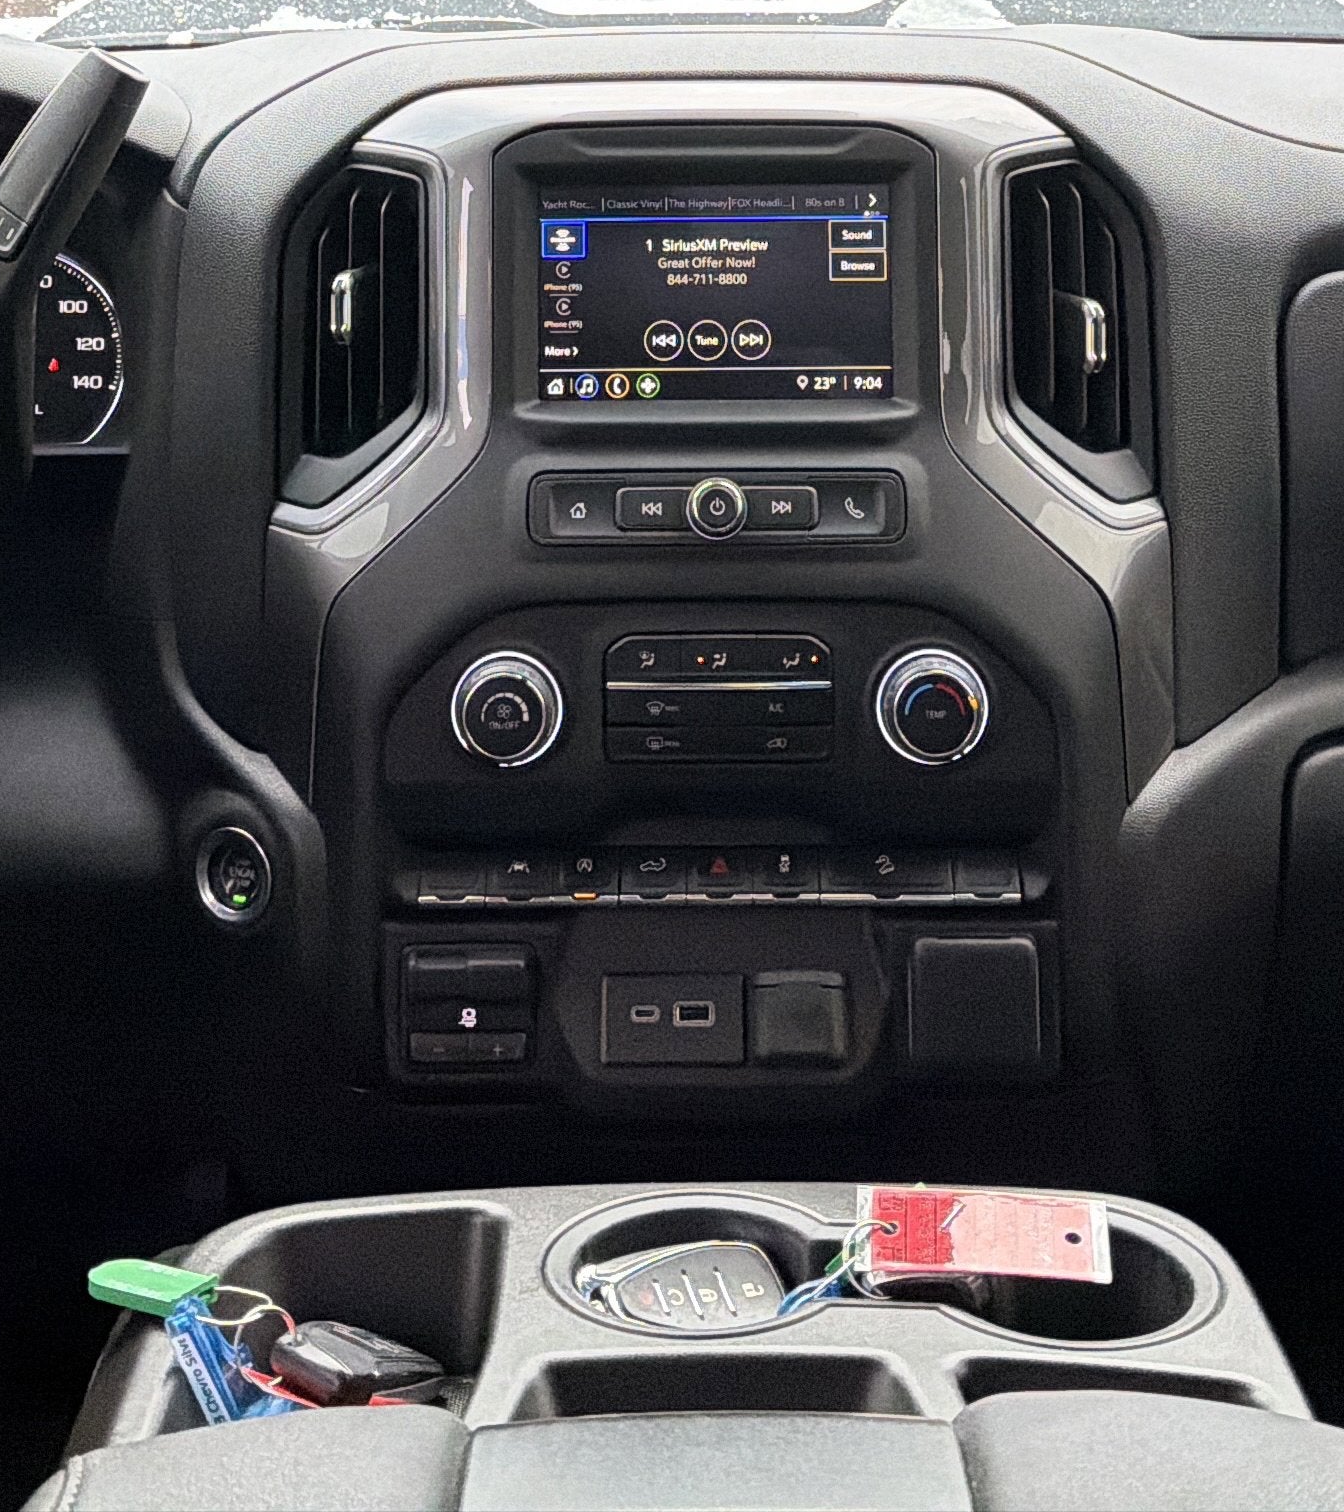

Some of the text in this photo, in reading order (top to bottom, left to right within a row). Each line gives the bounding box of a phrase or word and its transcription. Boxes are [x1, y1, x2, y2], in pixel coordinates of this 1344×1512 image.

[542, 200, 567, 210] Yacht
[607, 199, 663, 210] Classic Vinyl
[669, 199, 727, 210] The Highway
[731, 199, 751, 208] FOX
[805, 198, 822, 207] 80s
[824, 199, 836, 207] on
[841, 229, 873, 240] Sound
[645, 238, 769, 252] 1 SiriusXM Preview
[657, 256, 756, 269] Great Offer Now!
[840, 260, 876, 271] Browse
[666, 273, 748, 286] 844-711-8800
[58, 300, 88, 314] 100
[75, 337, 105, 351] 120
[695, 334, 719, 346] Tune
[544, 345, 571, 357] More
[72, 375, 103, 389] 140
[853, 376, 883, 390] 9:04
[34, 403, 44, 415] L
[768, 702, 784, 713] A/C
[925, 709, 947, 720] TEMP
[488, 720, 522, 730] ON/OFF
